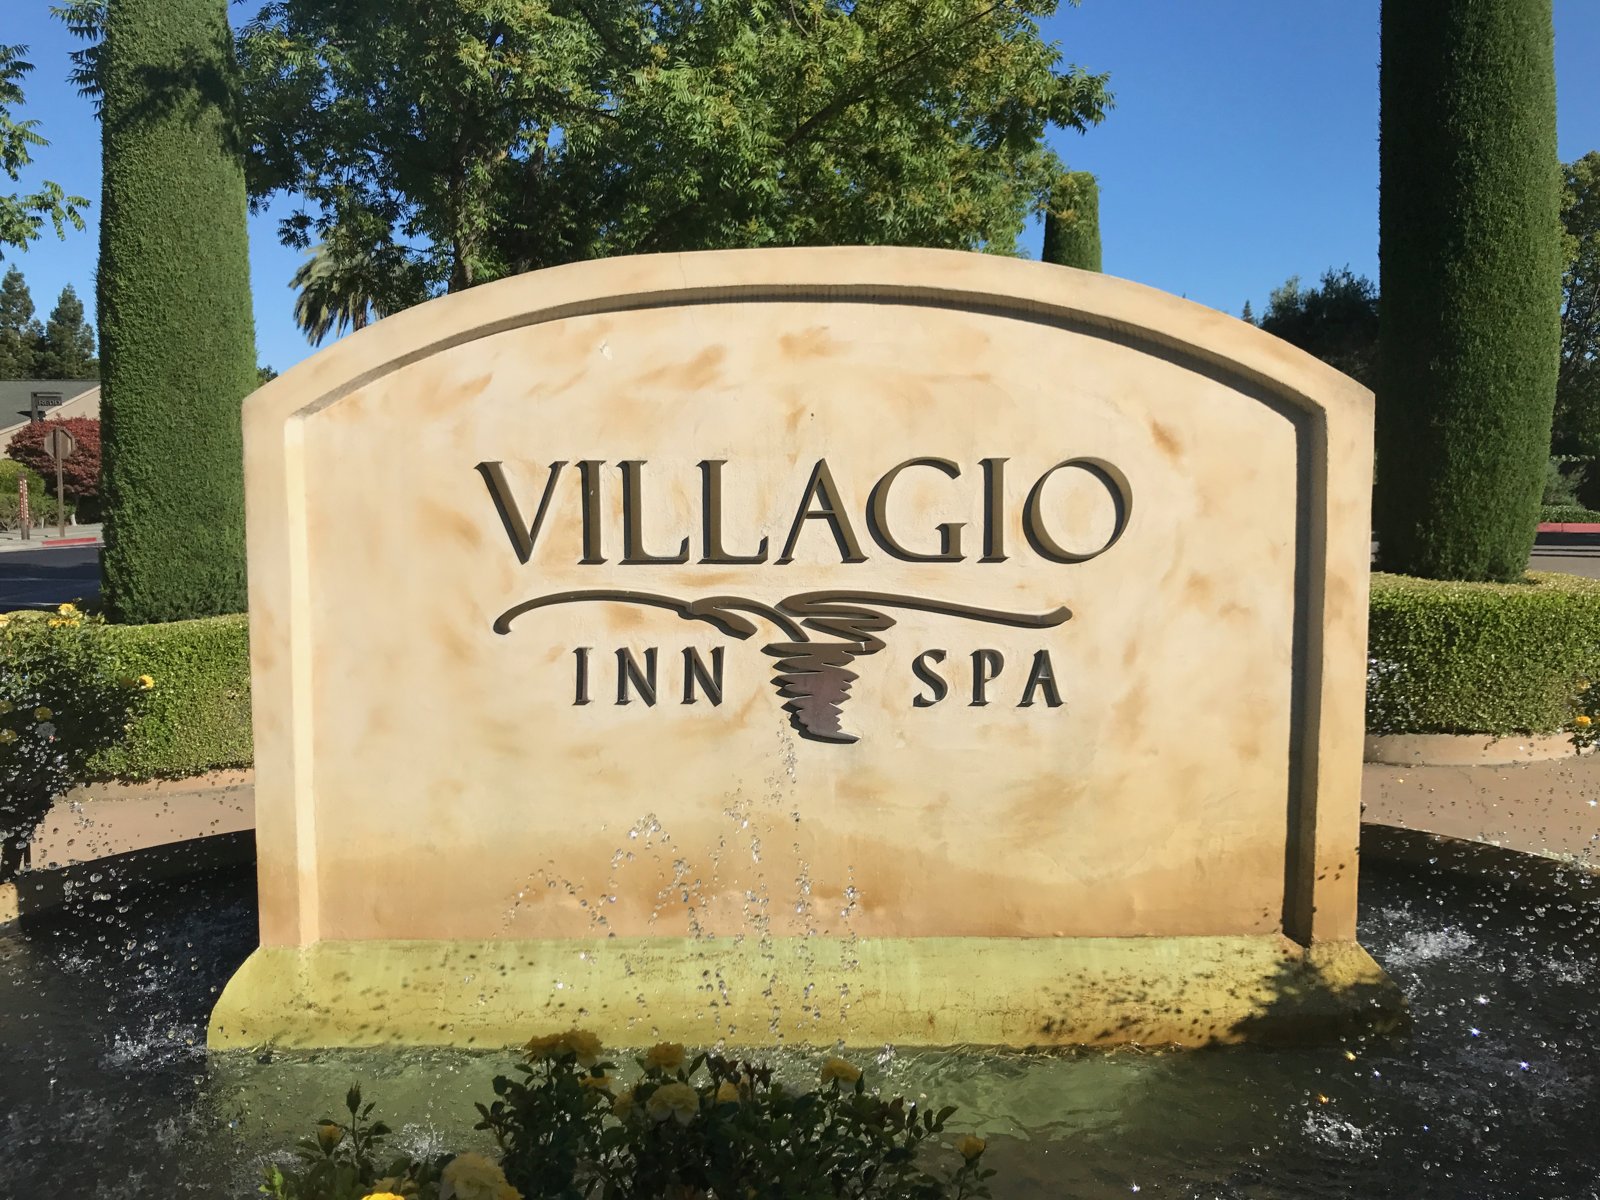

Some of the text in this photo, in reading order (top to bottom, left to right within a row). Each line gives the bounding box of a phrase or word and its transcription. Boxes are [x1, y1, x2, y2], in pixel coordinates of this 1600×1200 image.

[474, 456, 1134, 566] VILLAGIO
[571, 646, 1066, 709] INN SPA
